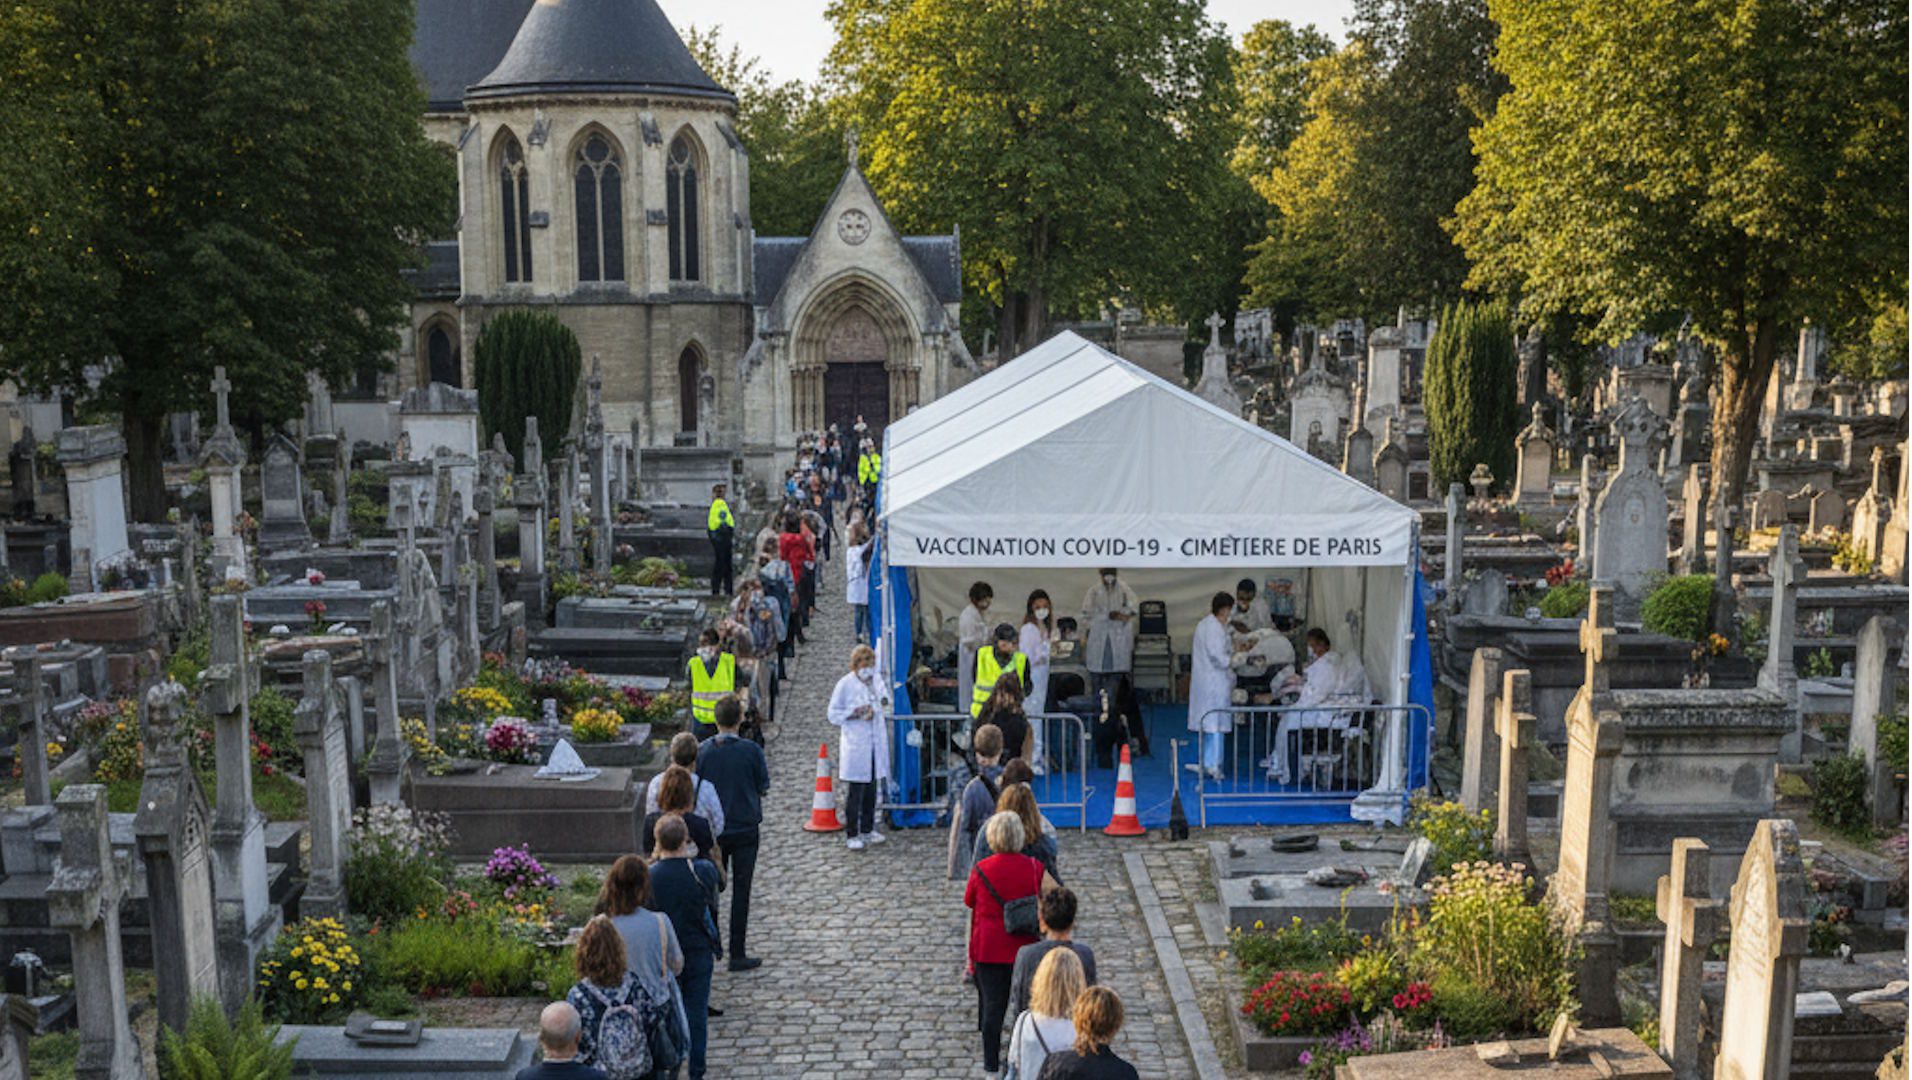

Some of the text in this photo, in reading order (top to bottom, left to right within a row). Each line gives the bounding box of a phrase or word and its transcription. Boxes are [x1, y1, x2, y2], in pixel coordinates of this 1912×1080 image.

[915, 536, 1056, 556] VACCINATION
[1062, 537, 1161, 557] COVID-19
[1292, 537, 1322, 556] DE
[1327, 537, 1383, 556] PARIS
